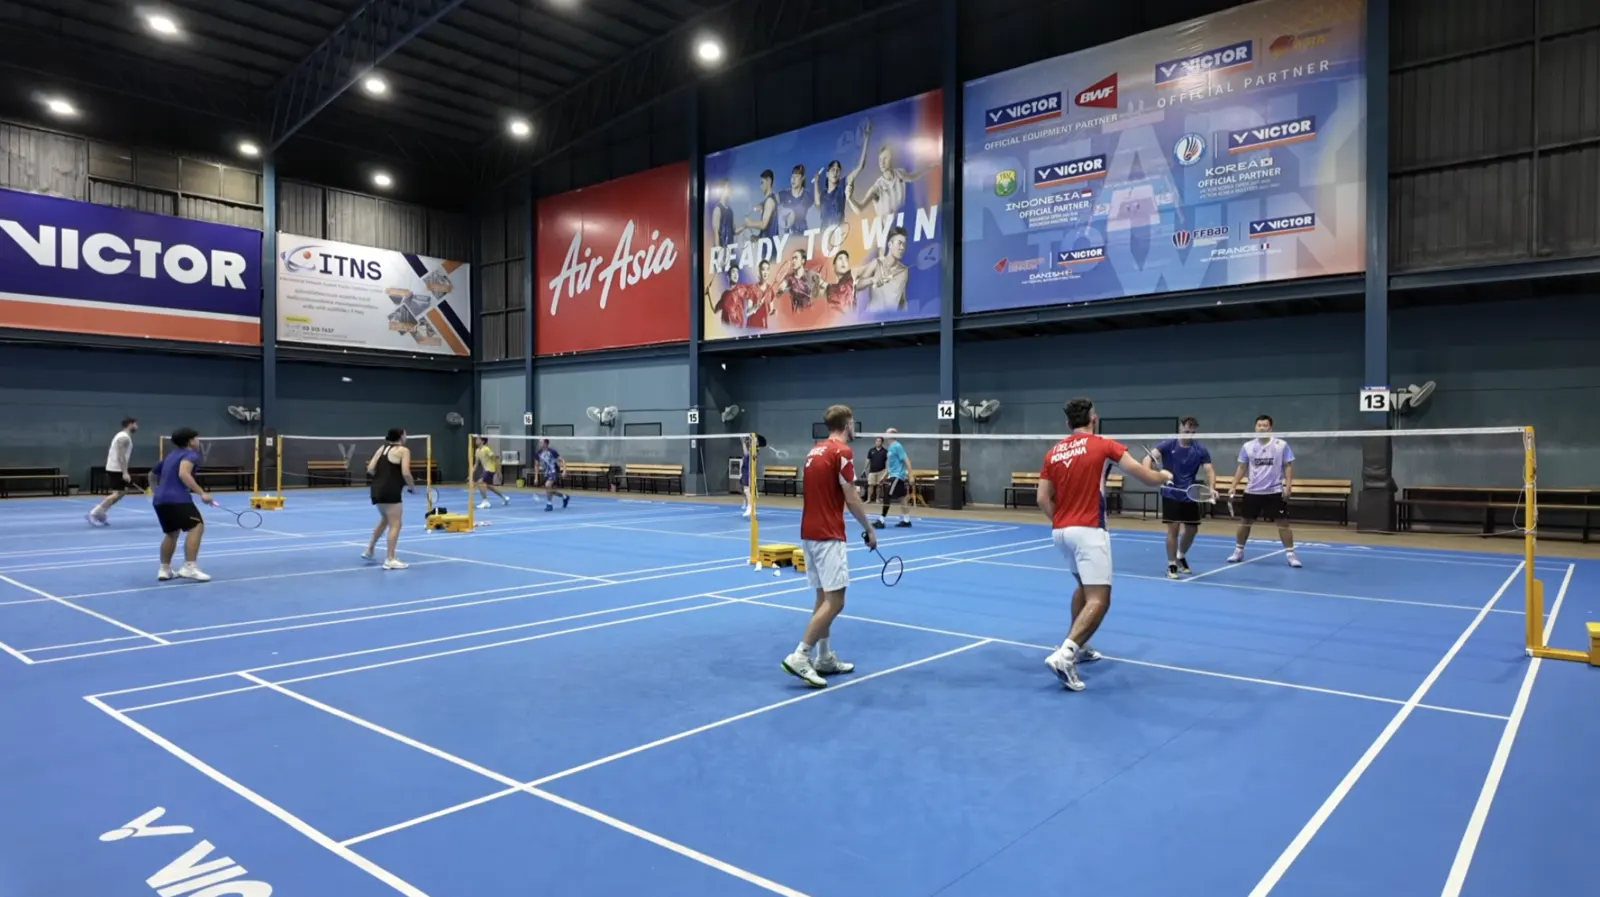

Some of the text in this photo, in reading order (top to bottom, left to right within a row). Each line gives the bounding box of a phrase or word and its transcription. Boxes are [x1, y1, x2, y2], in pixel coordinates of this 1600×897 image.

[1181, 46, 1247, 71] VICTOR
[1157, 60, 1329, 108] OFFICIAL PARTNER
[1080, 86, 1115, 103] BWF
[1006, 97, 1058, 118] VICTOR
[984, 113, 1118, 150] OFFICIAL EQUIPMENT PARTNER
[1252, 120, 1311, 140] VICTOR
[1054, 159, 1102, 176] VICTOR
[1205, 159, 1258, 176] KOREA
[1197, 176, 1237, 188] OFFICIAL
[1239, 168, 1281, 181] PARTNER
[1005, 192, 1080, 212] INDONESIA
[1019, 208, 1052, 219] OFFICIAL
[1053, 201, 1089, 213] PARTNER
[1267, 216, 1312, 229] VICTOR
[0, 219, 247, 290] VICTOR
[709, 234, 790, 275] READY
[804, 225, 842, 260] TO
[1070, 248, 1102, 259] VICTOR
[1210, 244, 1258, 257] FRANCE
[319, 253, 382, 281] ITNS
[1029, 271, 1064, 280] DANISH
[1365, 394, 1385, 409] 13
[689, 413, 697, 422] 15
[940, 406, 952, 417] 14
